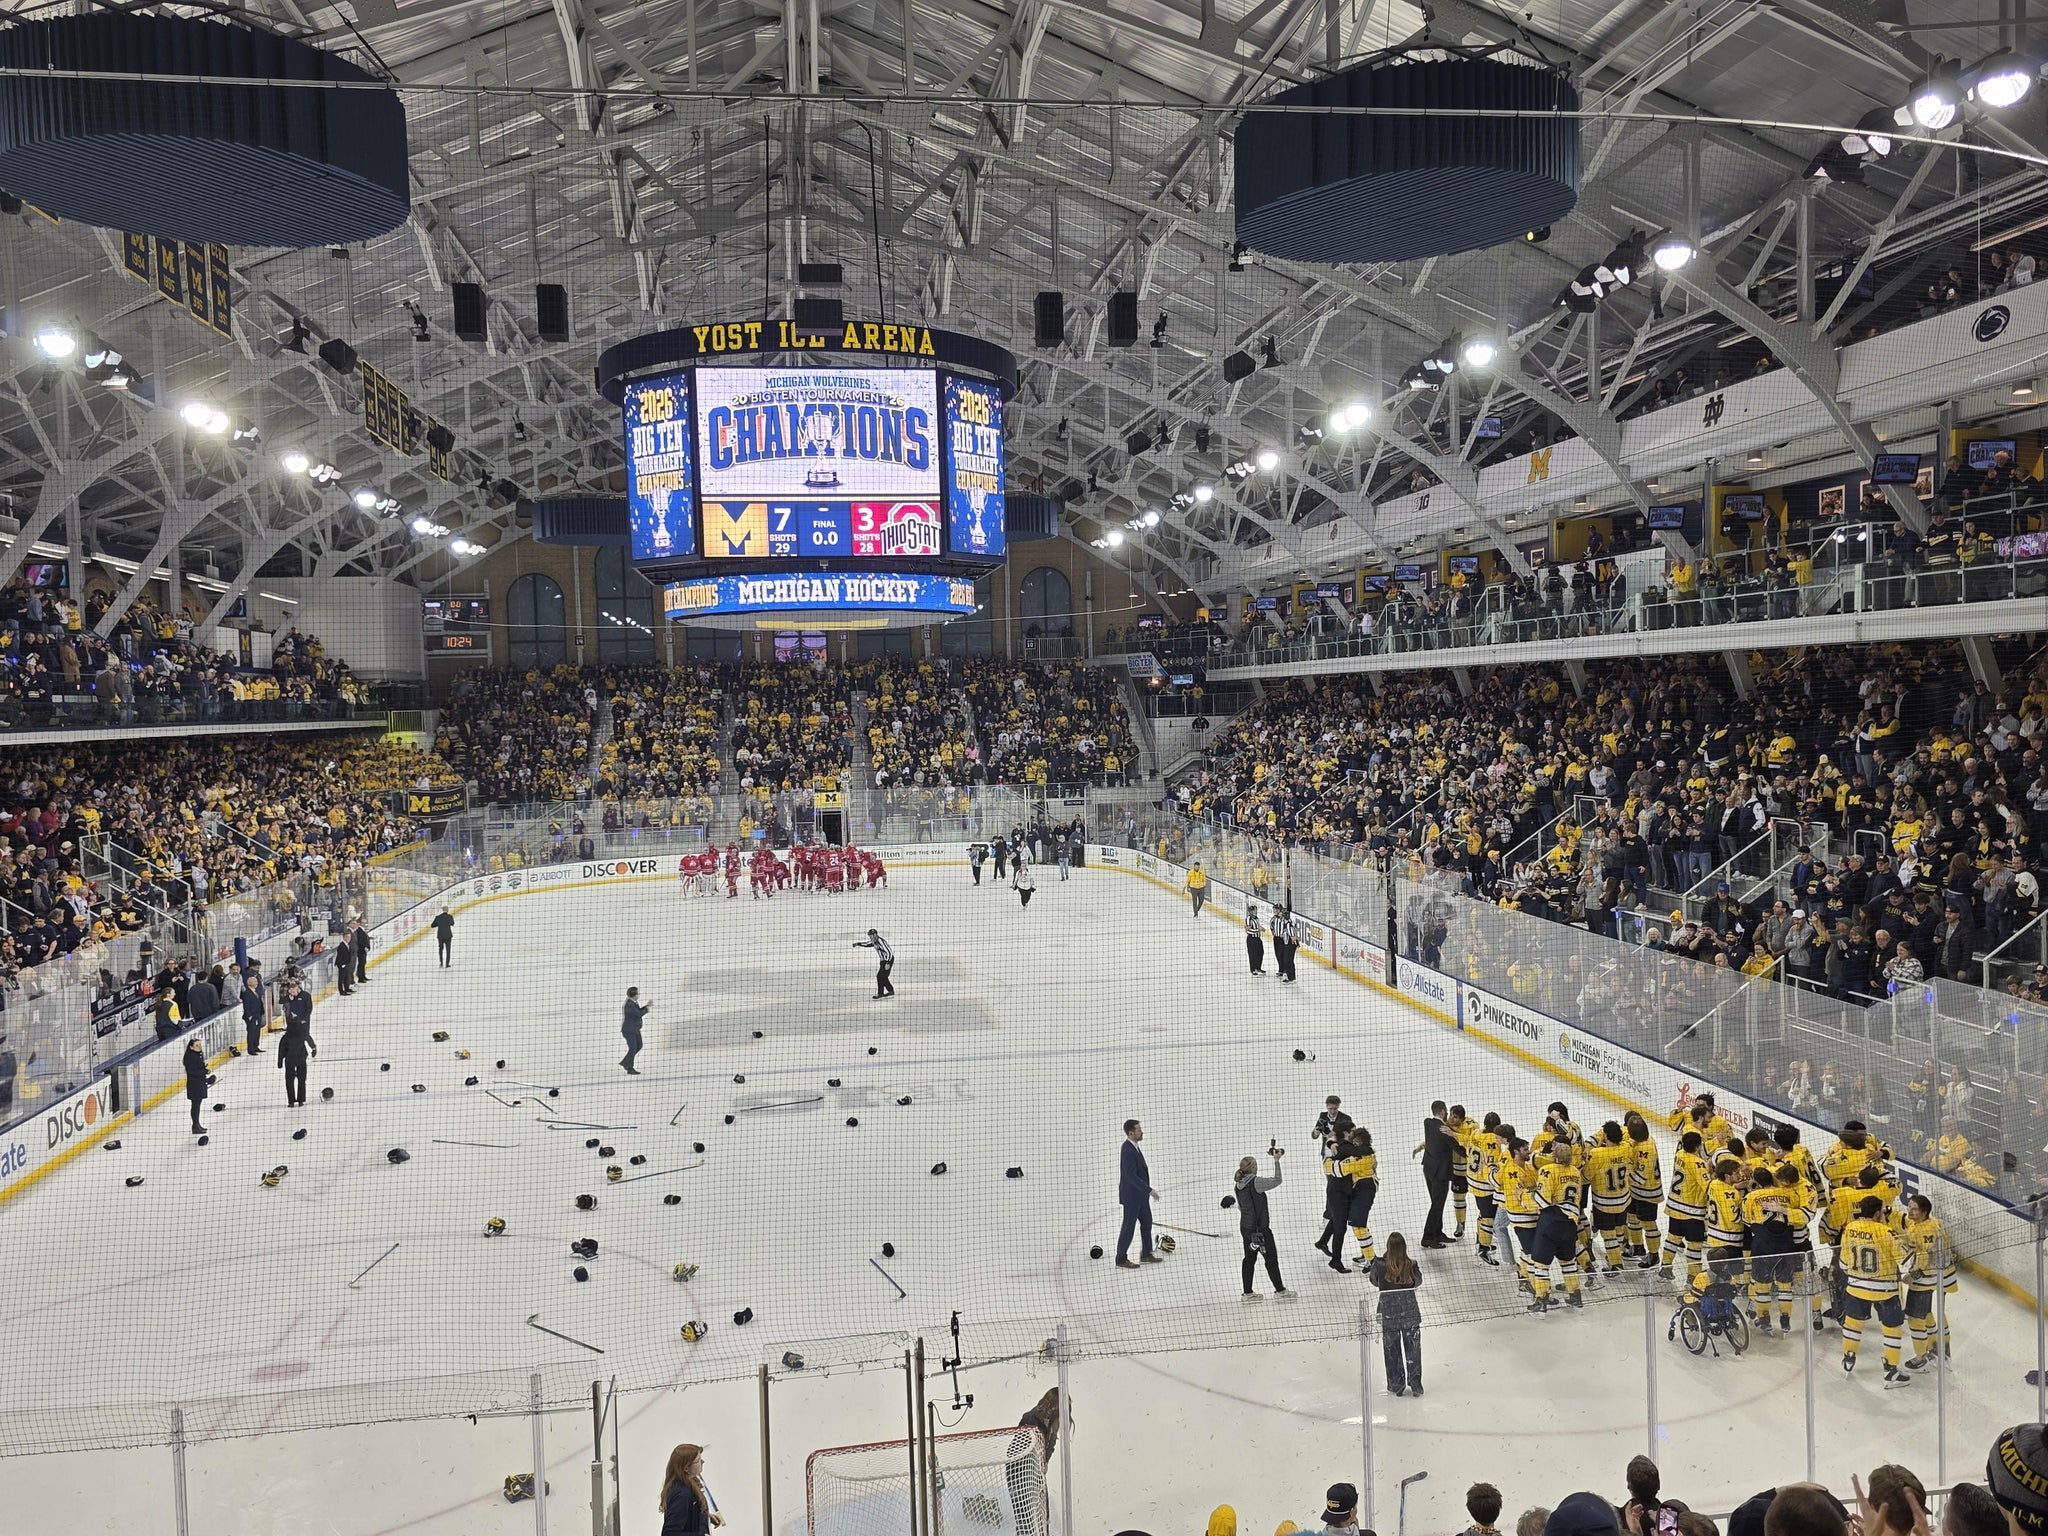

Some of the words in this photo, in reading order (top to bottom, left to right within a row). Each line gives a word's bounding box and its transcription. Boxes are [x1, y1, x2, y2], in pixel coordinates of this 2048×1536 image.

[693, 322, 762, 353] YOST
[842, 322, 935, 356] ARENA
[765, 376, 810, 389] MICHIGAN
[812, 376, 871, 389] WOLVERINES
[732, 394, 748, 404] 20
[750, 390, 770, 403] BIG
[773, 389, 798, 401] TEN
[800, 390, 887, 404] TOURNAMENT
[640, 388, 674, 424] 2026
[959, 389, 989, 425] 2026
[633, 425, 655, 457] BIG
[657, 420, 686, 453] TEN
[708, 403, 930, 472] CHAMPIONS
[953, 421, 973, 453] BIG
[975, 425, 999, 457] TEN
[634, 451, 684, 476] TOURNAMENT
[954, 450, 998, 476] TOURNAMENT
[1527, 447, 1553, 485] M
[636, 470, 685, 496] CHAMPIONS
[955, 469, 998, 495] CHAMPIONS
[774, 507, 791, 531] 7
[813, 520, 836, 528] FINAL
[858, 507, 874, 531] 3
[703, 504, 769, 556] M
[769, 533, 797, 542] SHOTS
[812, 531, 838, 545] 0.0
[853, 533, 880, 541] SHOTS
[775, 543, 790, 553] 29
[859, 543, 874, 553] 28
[674, 584, 718, 611] CHAMPIONS
[738, 579, 840, 604] MICHIGAN
[845, 578, 920, 603] HOCKEY
[241, 634, 250, 651] M
[447, 637, 472, 647] 10:24
[1128, 660, 1140, 668] BIG
[1141, 658, 1154, 667] TEN
[410, 795, 430, 813] M
[825, 793, 837, 802] M
[829, 856, 839, 866] 24
[1559, 854, 1572, 863] M
[539, 870, 571, 881] ABBOTT
[583, 860, 657, 878] DISCOVER
[121, 912, 136, 922] M
[1414, 974, 1445, 1002] Allstate
[1572, 1038, 1600, 1059] MICHIGAN
[1572, 1050, 1600, 1073] LOTTERY
[1603, 1051, 1615, 1067] For
[1603, 1066, 1616, 1081] For
[47, 1084, 112, 1150] DISCOV
[1487, 1142, 1496, 1150] M
[1611, 1157, 1623, 1165] HAGE
[1639, 1151, 1649, 1159] M
[1508, 1171, 1518, 1179] M
[1540, 1169, 1550, 1178] M
[1606, 1166, 1626, 1191] 19
[1724, 1191, 1735, 1200] M
[1755, 1195, 1791, 1206] ROBERTSON
[1849, 1229, 1874, 1241] SCHOCK
[1923, 1235, 1934, 1244] M
[1851, 1243, 1878, 1274] 10
